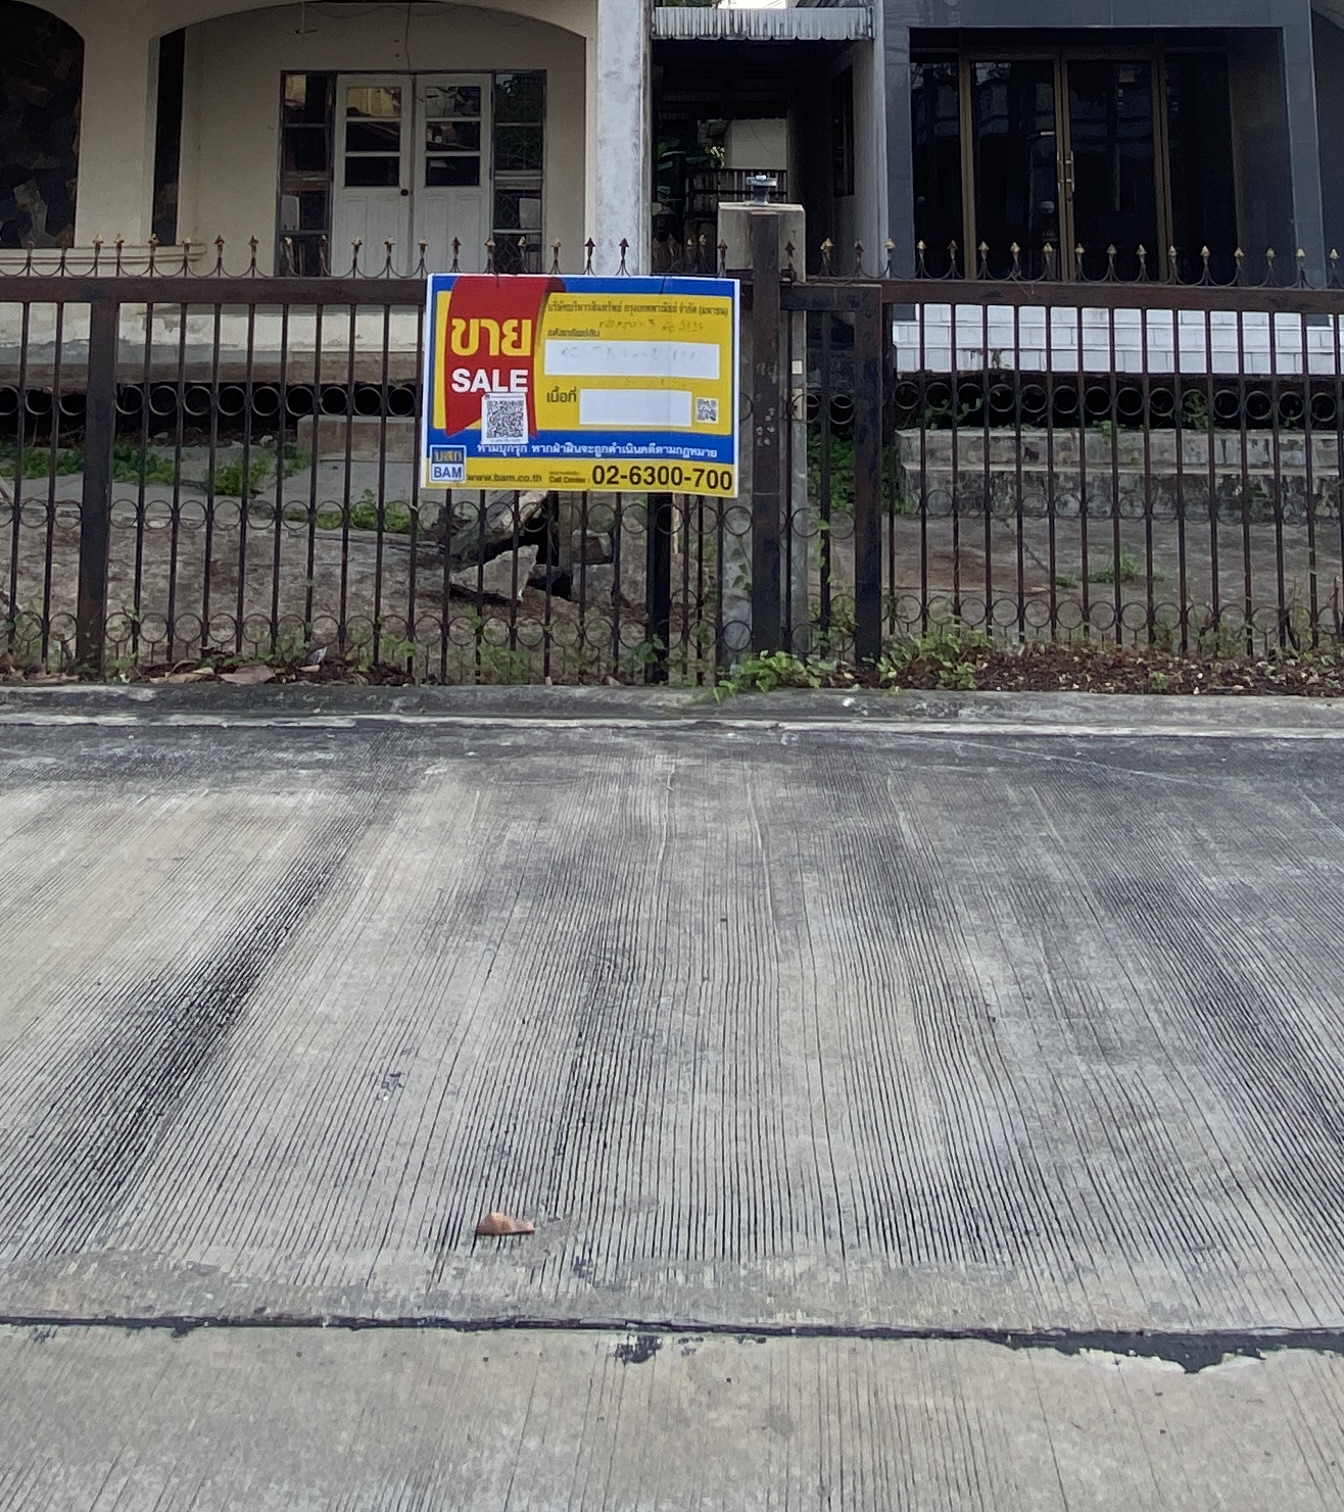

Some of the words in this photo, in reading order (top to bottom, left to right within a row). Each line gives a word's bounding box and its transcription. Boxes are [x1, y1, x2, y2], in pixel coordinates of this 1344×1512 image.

[451, 318, 532, 357] ขาย
[451, 368, 529, 393] SALE
[546, 385, 577, 403] เนื้อที่
[477, 444, 528, 458] หามบุกรุก
[433, 466, 463, 479] BAM
[592, 464, 733, 491] 02-6300-700
